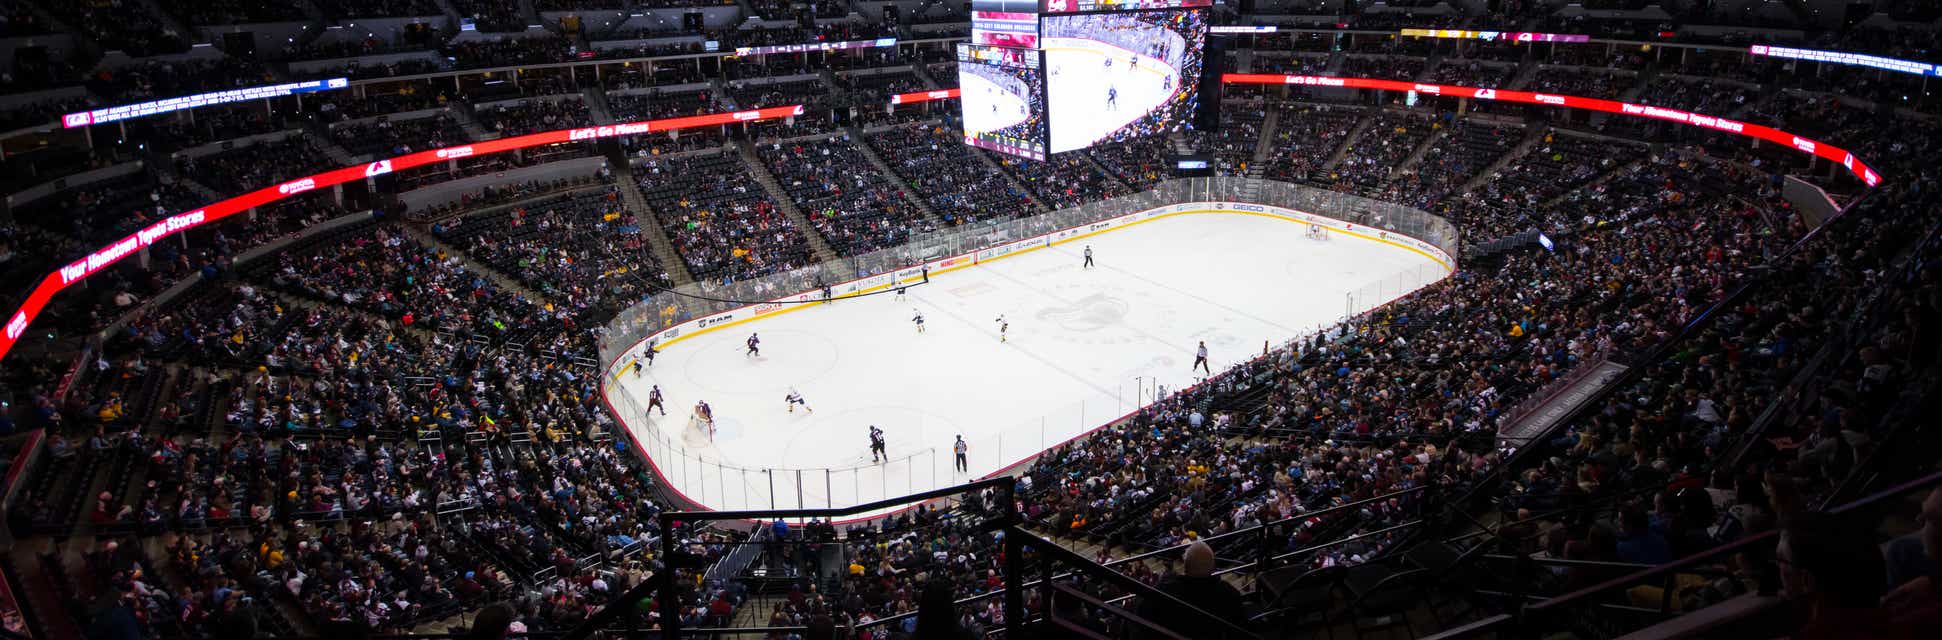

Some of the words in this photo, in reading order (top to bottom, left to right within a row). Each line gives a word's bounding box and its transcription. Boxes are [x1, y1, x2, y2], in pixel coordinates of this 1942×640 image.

[1286, 76, 1304, 84] Let's
[1306, 77, 1316, 85] Go
[1318, 78, 1344, 86] Places
[1622, 104, 1644, 114] Your
[1646, 106, 1688, 121] Hometown
[1688, 113, 1716, 127] Toyota
[1716, 118, 1744, 132] Stores
[570, 129, 596, 140] Let's
[598, 126, 612, 137] Go
[615, 123, 648, 134] Places
[1234, 204, 1264, 212] GEICO
[60, 261, 86, 284] Your
[88, 236, 138, 272] Hometown
[138, 222, 167, 245] Toyota
[167, 210, 205, 231] Stores
[709, 314, 732, 324] RAM
